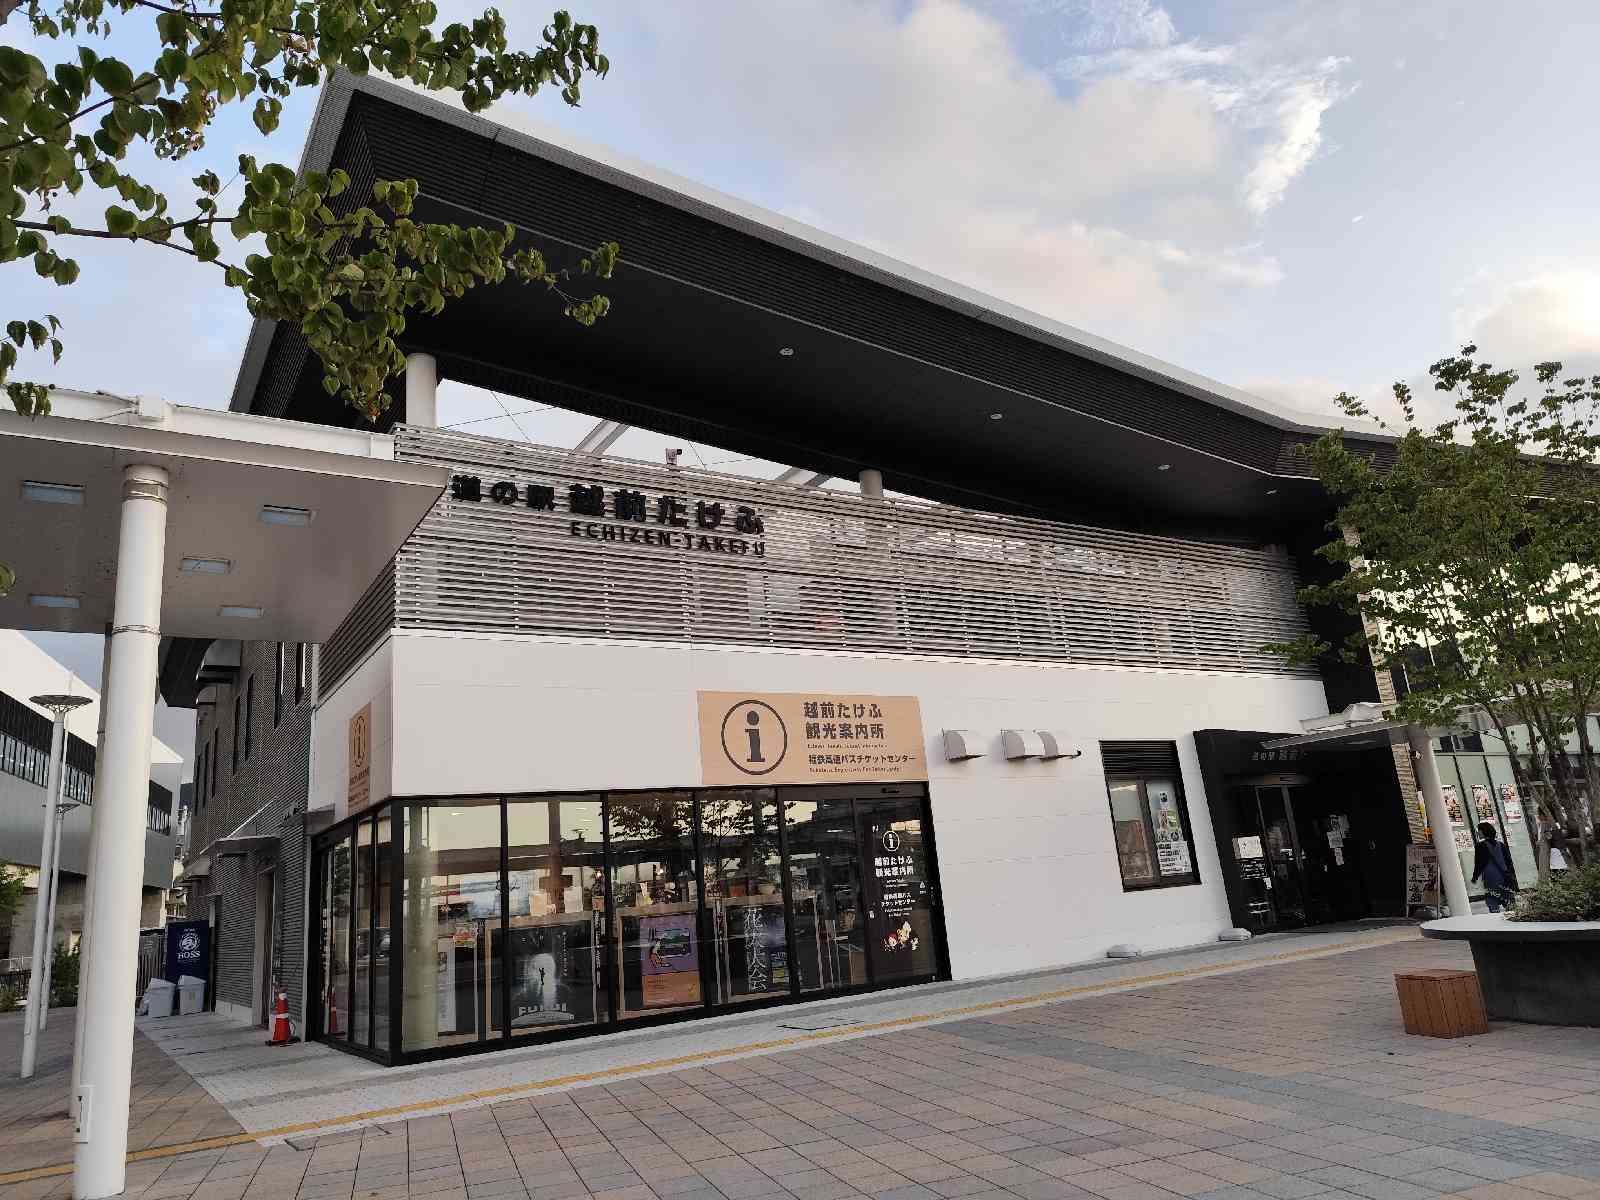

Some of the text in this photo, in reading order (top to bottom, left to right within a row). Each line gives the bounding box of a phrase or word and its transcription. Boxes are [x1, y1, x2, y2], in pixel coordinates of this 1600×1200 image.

[803, 701, 882, 719] 越前たけふ
[805, 722, 884, 740] 観光案内所
